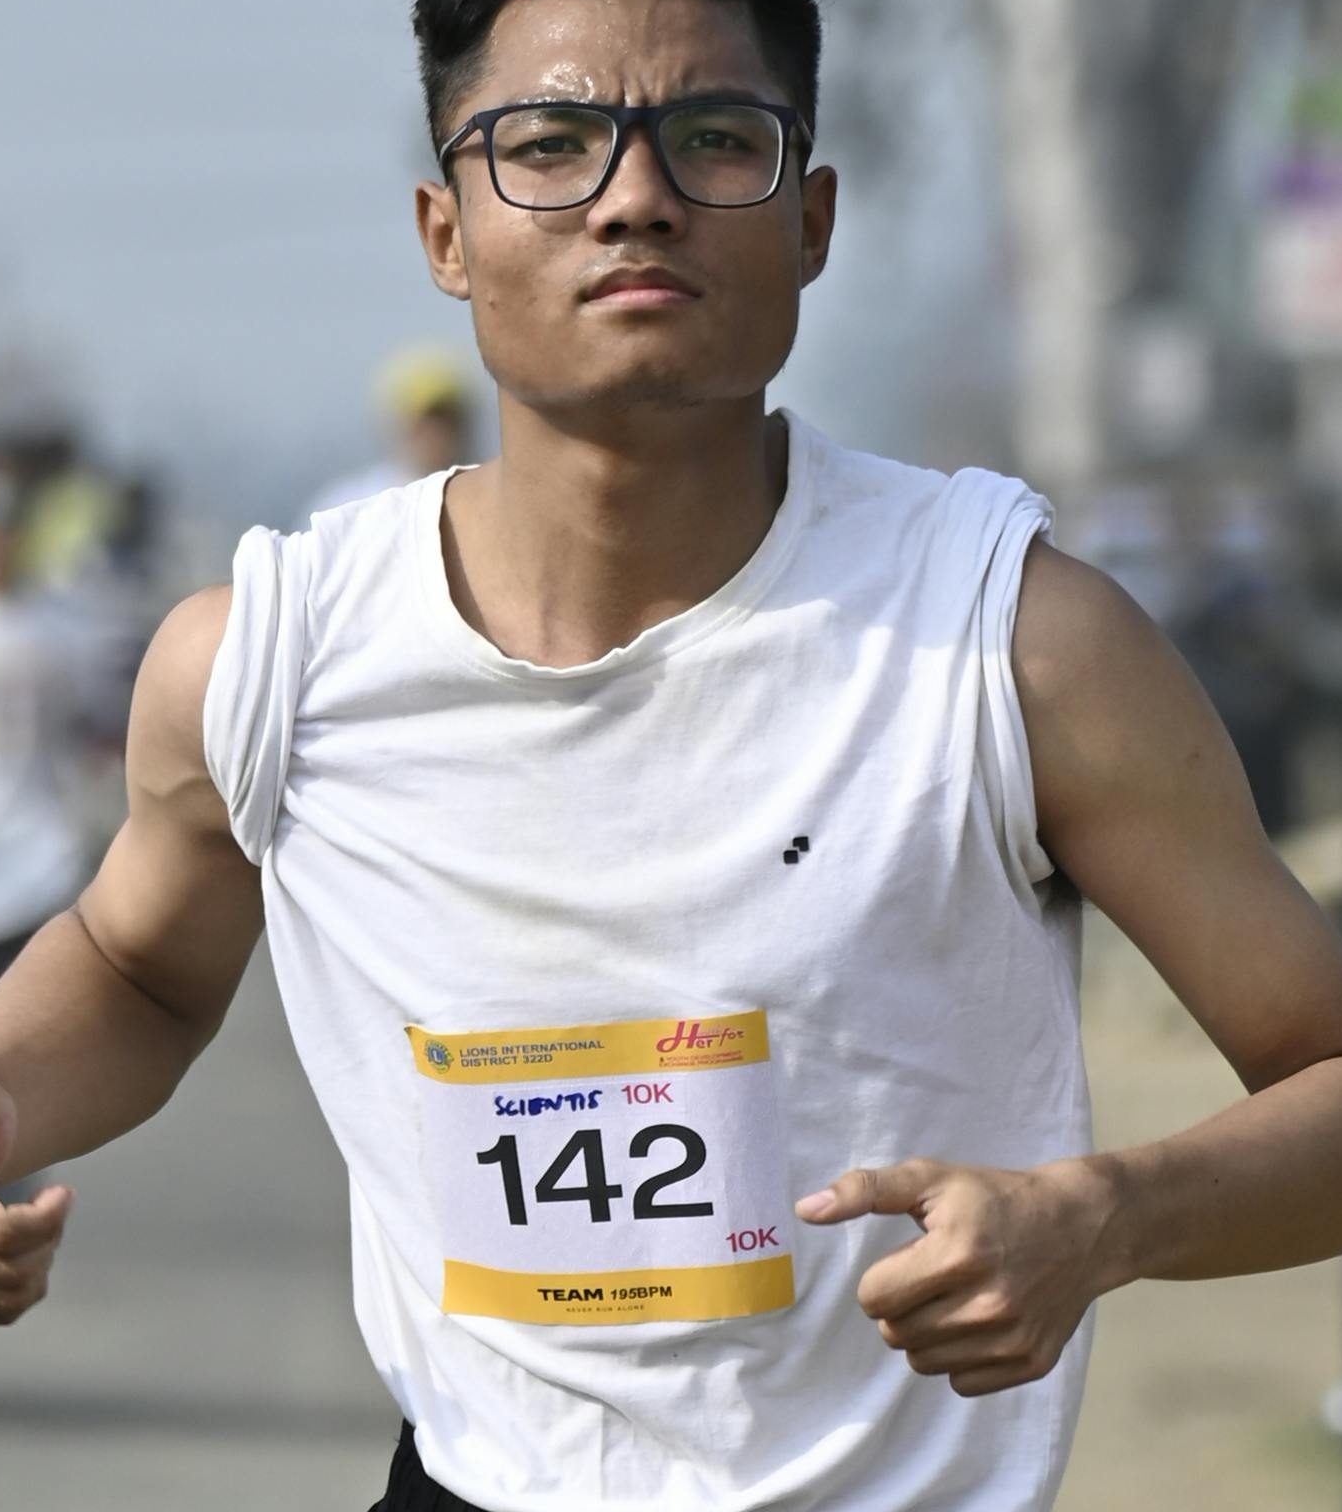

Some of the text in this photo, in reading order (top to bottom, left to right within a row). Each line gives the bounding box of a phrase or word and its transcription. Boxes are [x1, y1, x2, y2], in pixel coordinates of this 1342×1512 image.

[656, 1021, 717, 1053] Her
[459, 1040, 605, 1058] LIONS INTERNATIONAL
[460, 1053, 554, 1068] DISTRICT 322D
[621, 1083, 674, 1105] 10K
[475, 1123, 715, 1226] 142
[725, 1225, 780, 1253] 10K
[537, 1285, 673, 1301] TEAM 195BPM
